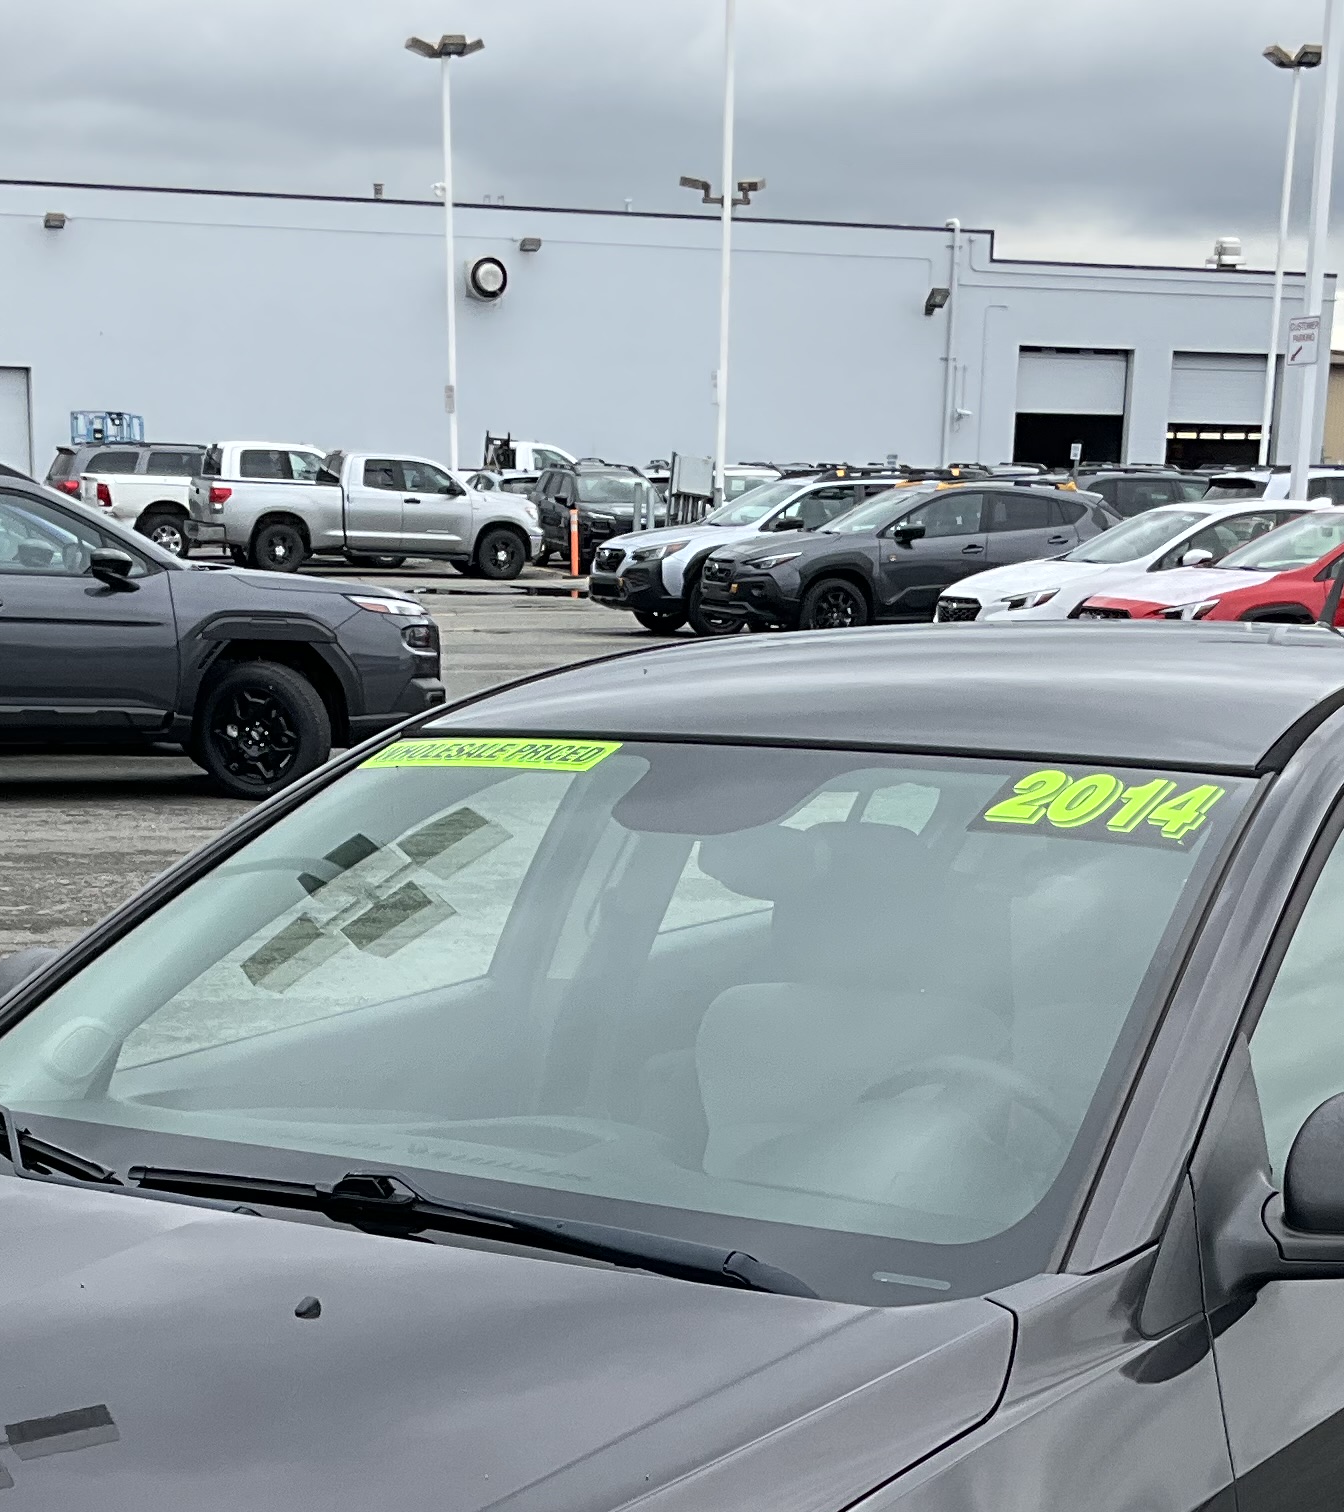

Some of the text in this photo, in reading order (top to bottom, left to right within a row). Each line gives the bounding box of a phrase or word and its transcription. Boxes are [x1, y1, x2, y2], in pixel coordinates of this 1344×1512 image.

[374, 742, 606, 765] WHOLESALE PRICED
[984, 769, 1226, 839] 2014
